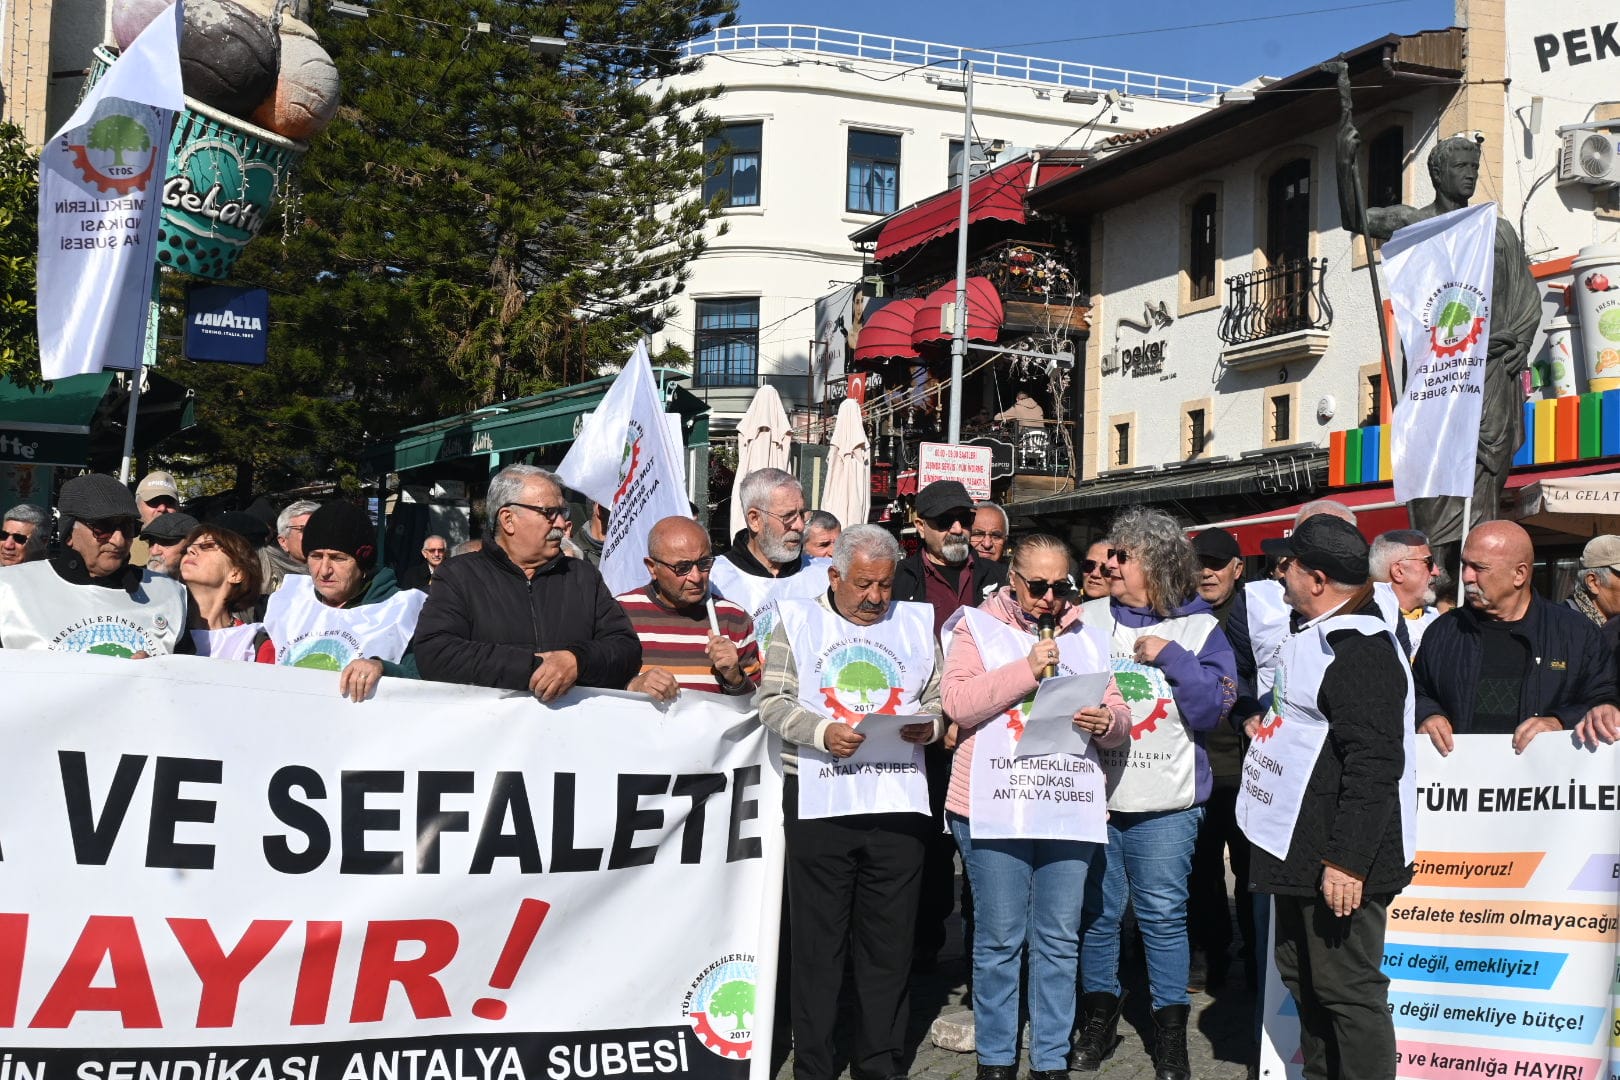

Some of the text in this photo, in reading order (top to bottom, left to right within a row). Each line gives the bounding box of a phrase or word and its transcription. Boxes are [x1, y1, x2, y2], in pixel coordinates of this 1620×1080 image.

[1533, 22, 1620, 73] PEK
[1595, 299, 1616, 314] FRESH
[194, 310, 262, 330] LAVAZZA
[1122, 340, 1166, 376] peker
[1555, 490, 1570, 501] LA
[854, 704, 874, 712] 2017
[818, 763, 872, 779] ANTALYA
[990, 756, 1095, 774] TÜM EMEKLİLERİN
[1009, 774, 1074, 788] SENDİKASI
[993, 788, 1094, 803] ANTALYA ŞUBESİ
[57, 750, 763, 875] VE SEFALETE
[1391, 906, 1455, 923] sefalete
[1459, 909, 1505, 925] teslim
[0, 897, 550, 1030] AYIR!
[1407, 953, 1450, 973] değil,
[1454, 957, 1539, 978] emekliyiz!
[1400, 1001, 1440, 1022] değil
[1443, 1005, 1517, 1028] emekliye
[1522, 1010, 1584, 1032] bütçe!
[730, 1031, 751, 1040] 2017
[76, 1052, 320, 1080] SENDİKASI
[342, 1046, 526, 1080] ANTALYA
[546, 1031, 690, 1080] ŞUBESİ
[1408, 1053, 1427, 1066] ve
[1430, 1052, 1508, 1077] karanlığa
[1513, 1060, 1584, 1080] HAYIR!
